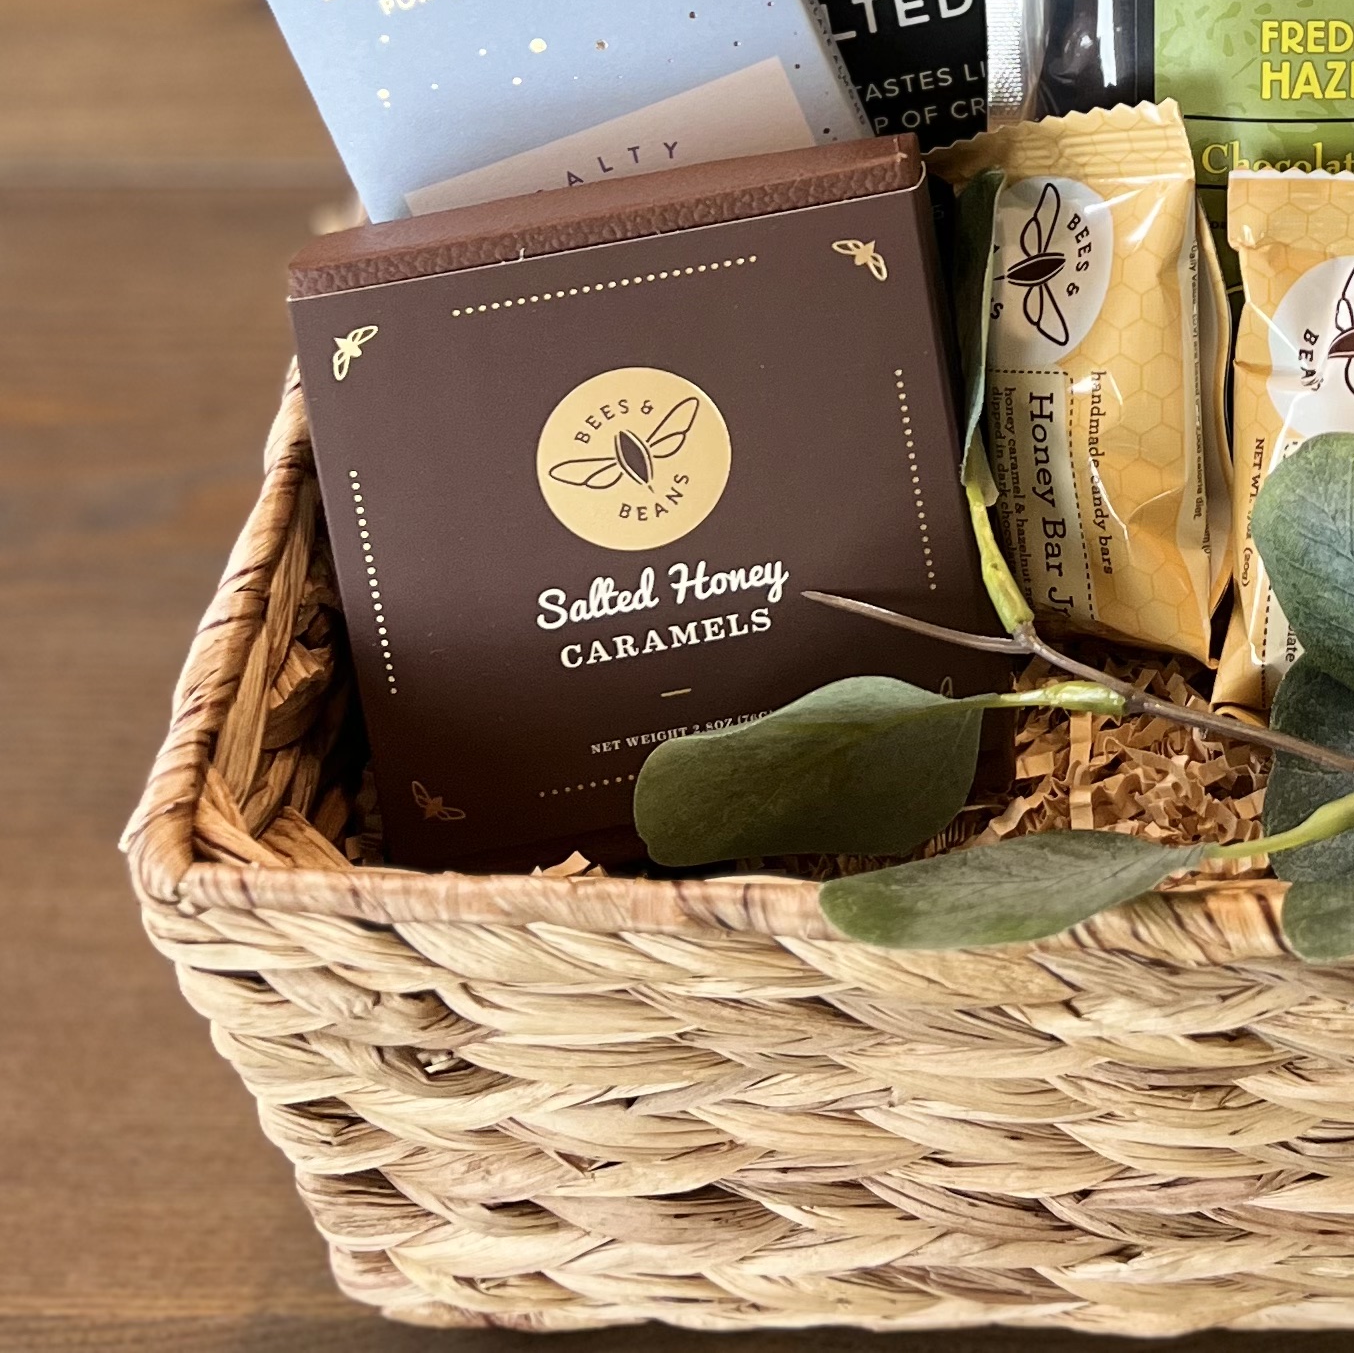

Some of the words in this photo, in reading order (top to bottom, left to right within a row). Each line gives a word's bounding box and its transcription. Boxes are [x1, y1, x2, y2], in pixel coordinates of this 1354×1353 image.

[855, 67, 952, 102] ASTES
[901, 105, 938, 129] OF
[536, 141, 679, 193] ALTY
[1067, 213, 1092, 272] BEES
[1066, 282, 1080, 296] &
[574, 399, 630, 444] BEES
[640, 399, 654, 415] &
[1004, 387, 1016, 436] honey
[1088, 371, 1107, 468] handmade
[1008, 438, 1026, 500] caramel
[1029, 392, 1056, 508] Honey
[1252, 438, 1265, 474] NET
[619, 472, 690, 522] BEANS
[1091, 474, 1111, 534] candy
[1042, 516, 1067, 578] Bar
[1099, 536, 1113, 575] bars
[1241, 547, 1254, 587] (20g)
[536, 566, 660, 630] Salted
[668, 560, 790, 606] Honey
[560, 607, 772, 669] CARAMELS
[590, 739, 622, 755] NET
[626, 726, 688, 747] WEIGHT
